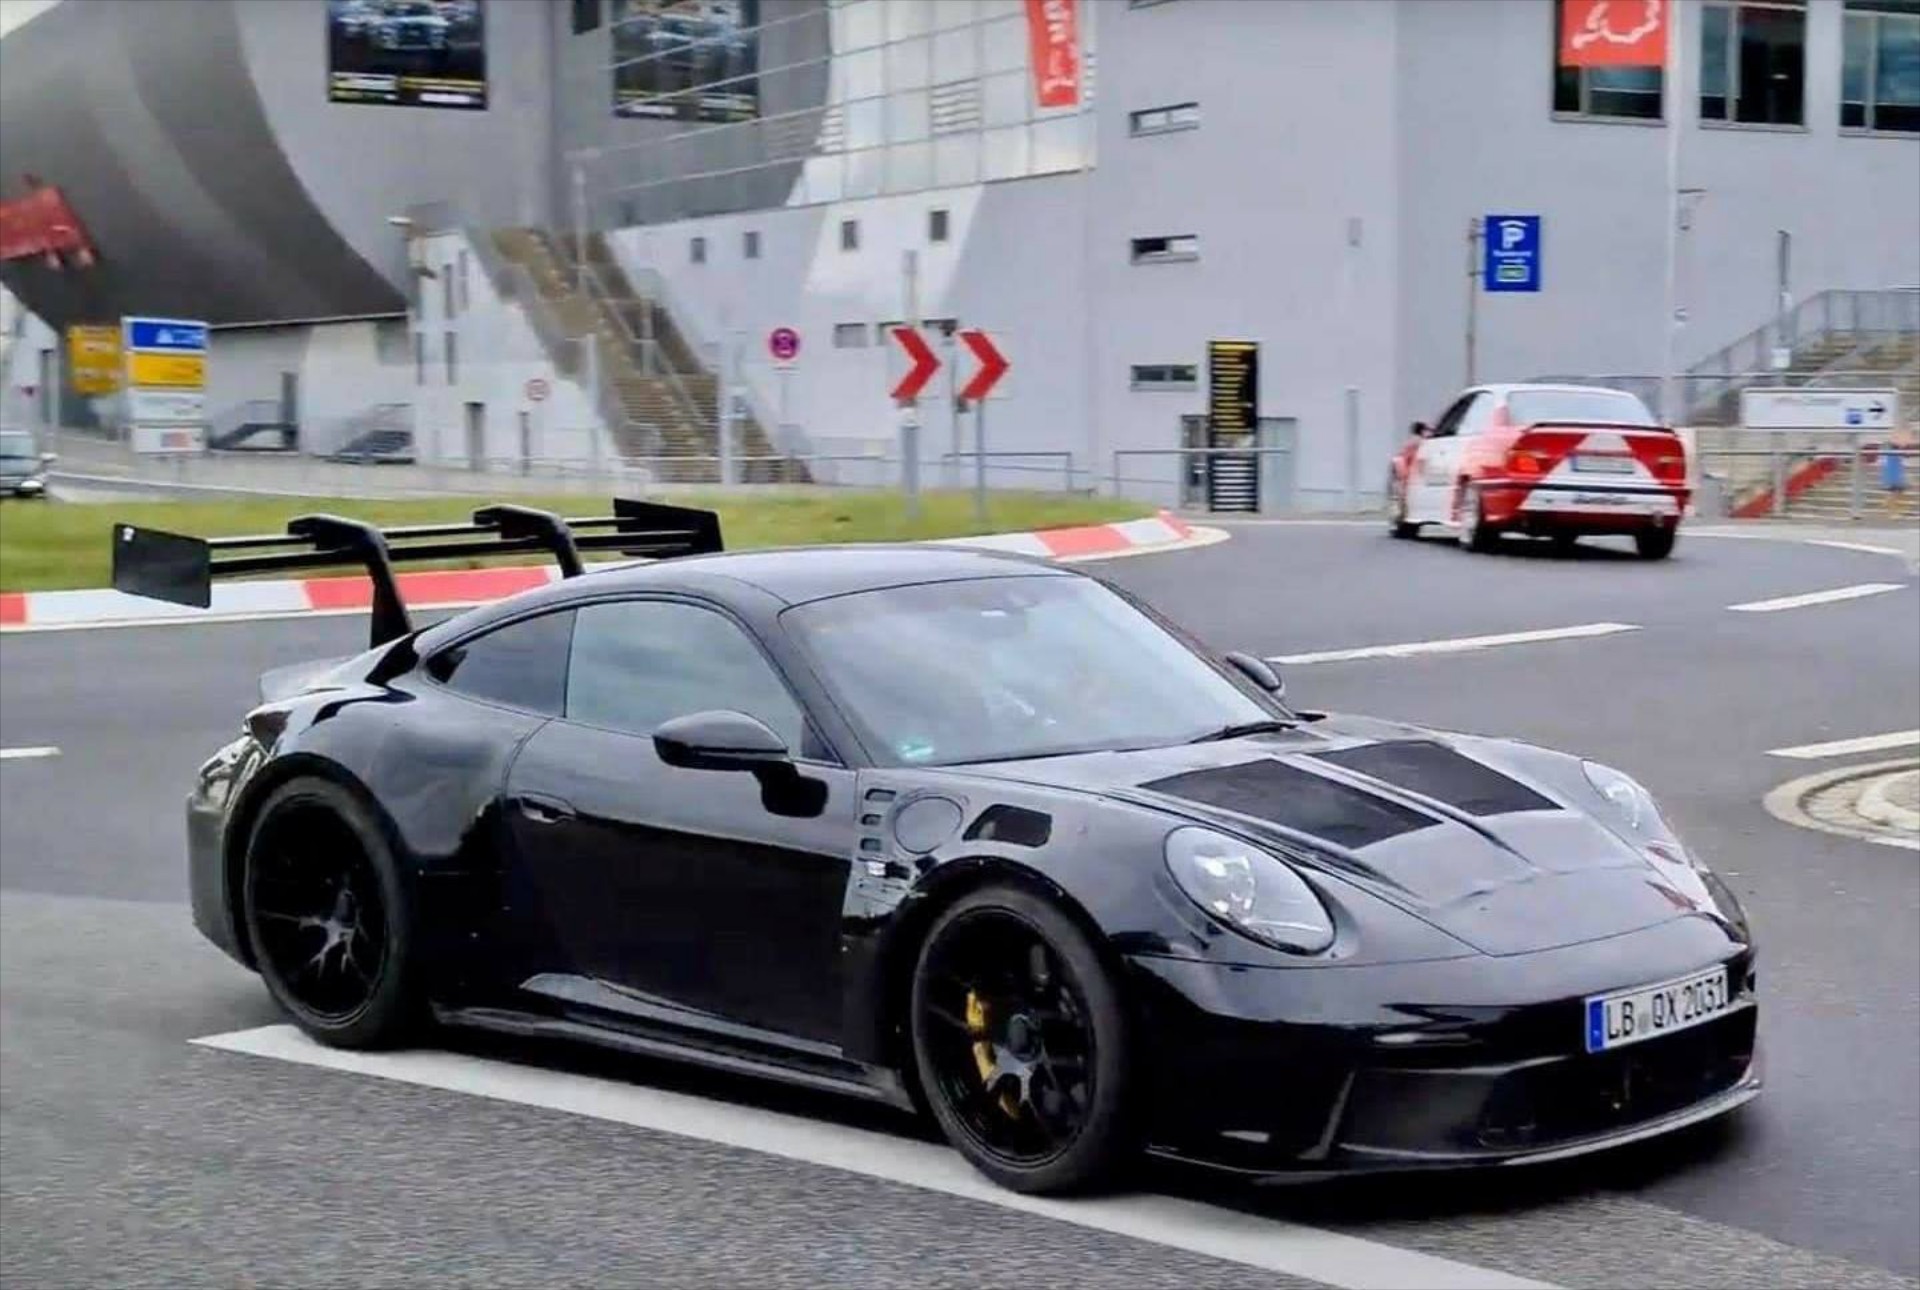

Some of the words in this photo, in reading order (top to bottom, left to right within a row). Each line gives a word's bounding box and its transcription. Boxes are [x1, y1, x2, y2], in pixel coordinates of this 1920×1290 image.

[1502, 227, 1525, 249] P
[1606, 1001, 1634, 1039] LB
[1652, 988, 1678, 1028] QX
[1682, 976, 1725, 1020] 2031
